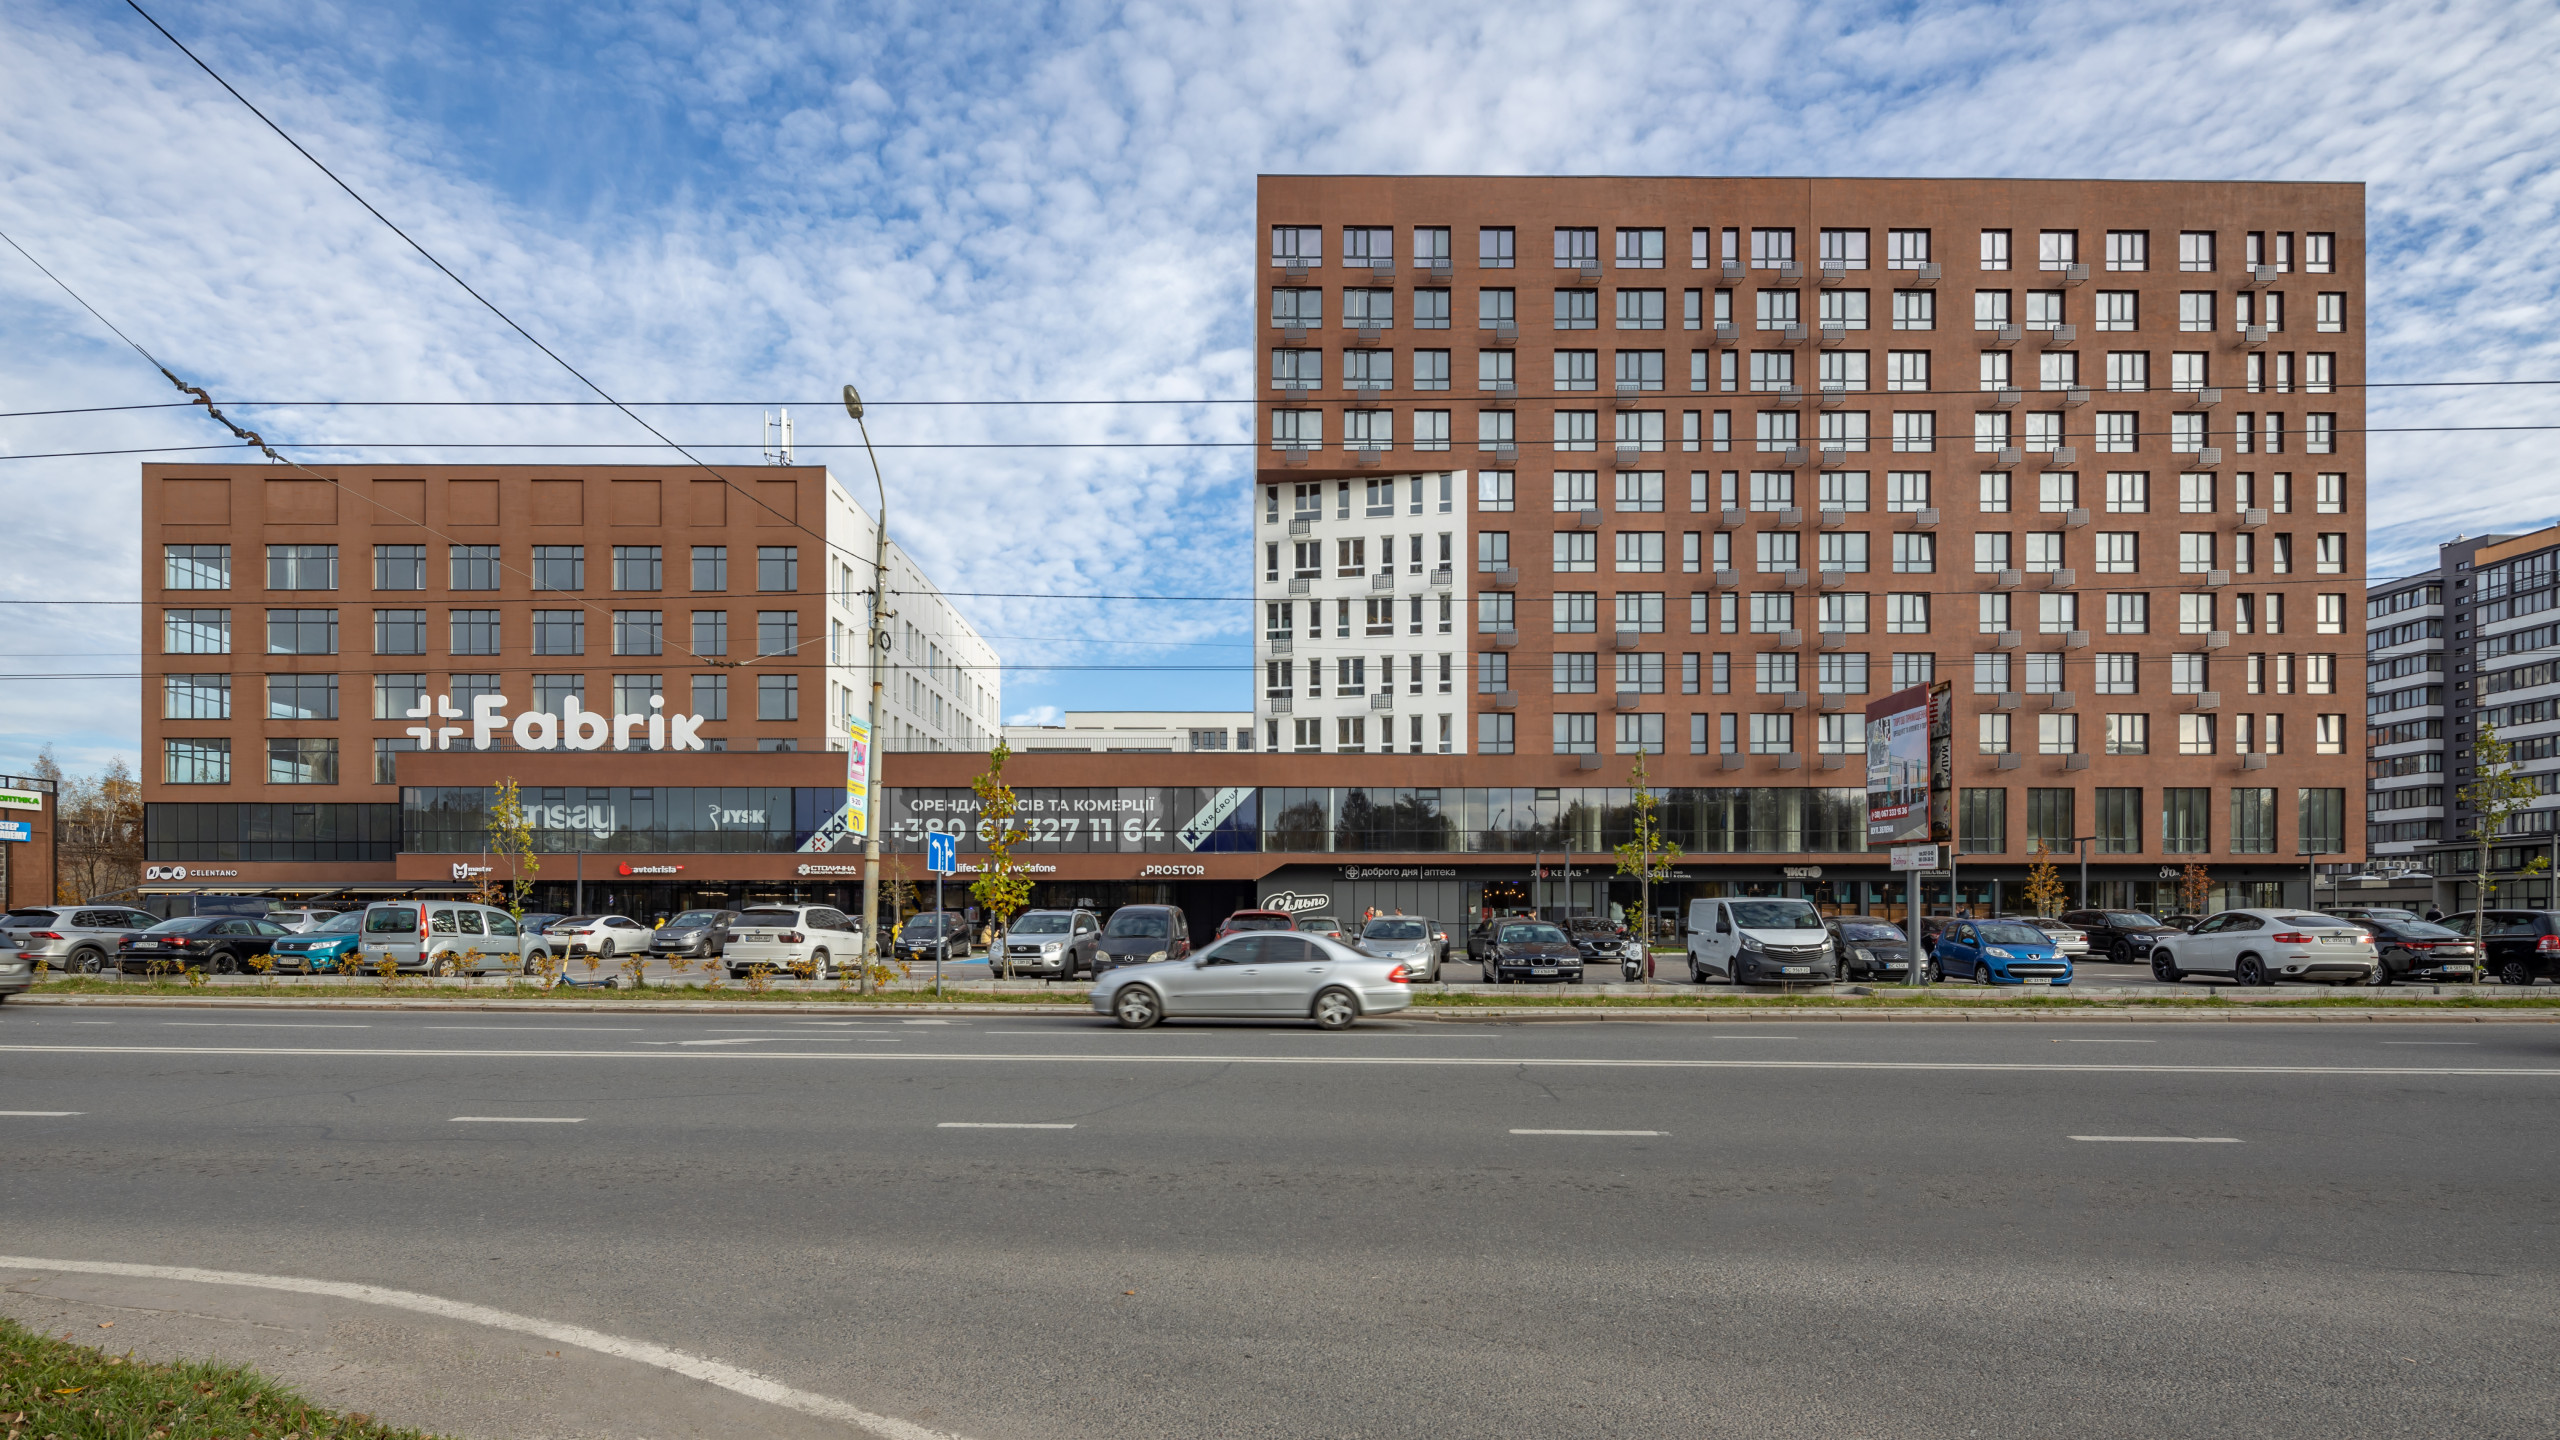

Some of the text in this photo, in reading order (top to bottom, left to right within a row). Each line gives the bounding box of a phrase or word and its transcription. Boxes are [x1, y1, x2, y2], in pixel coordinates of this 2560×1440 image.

[473, 694, 705, 751] Fabrik
[911, 799, 981, 813] ОРЕНДА
[1048, 799, 1071, 812] ТА
[1074, 796, 1156, 814] КОМЕРЦІЇ
[1201, 789, 1239, 827] WR GROUP
[722, 809, 766, 824] JYSK
[890, 818, 967, 843] +380
[1024, 818, 1080, 842] 327
[1089, 818, 1112, 842] 11
[1123, 817, 1165, 842] 64
[1361, 867, 1418, 878] доброго дня
[1424, 868, 1456, 876] аптека
[1268, 895, 1326, 912] Сільпо
